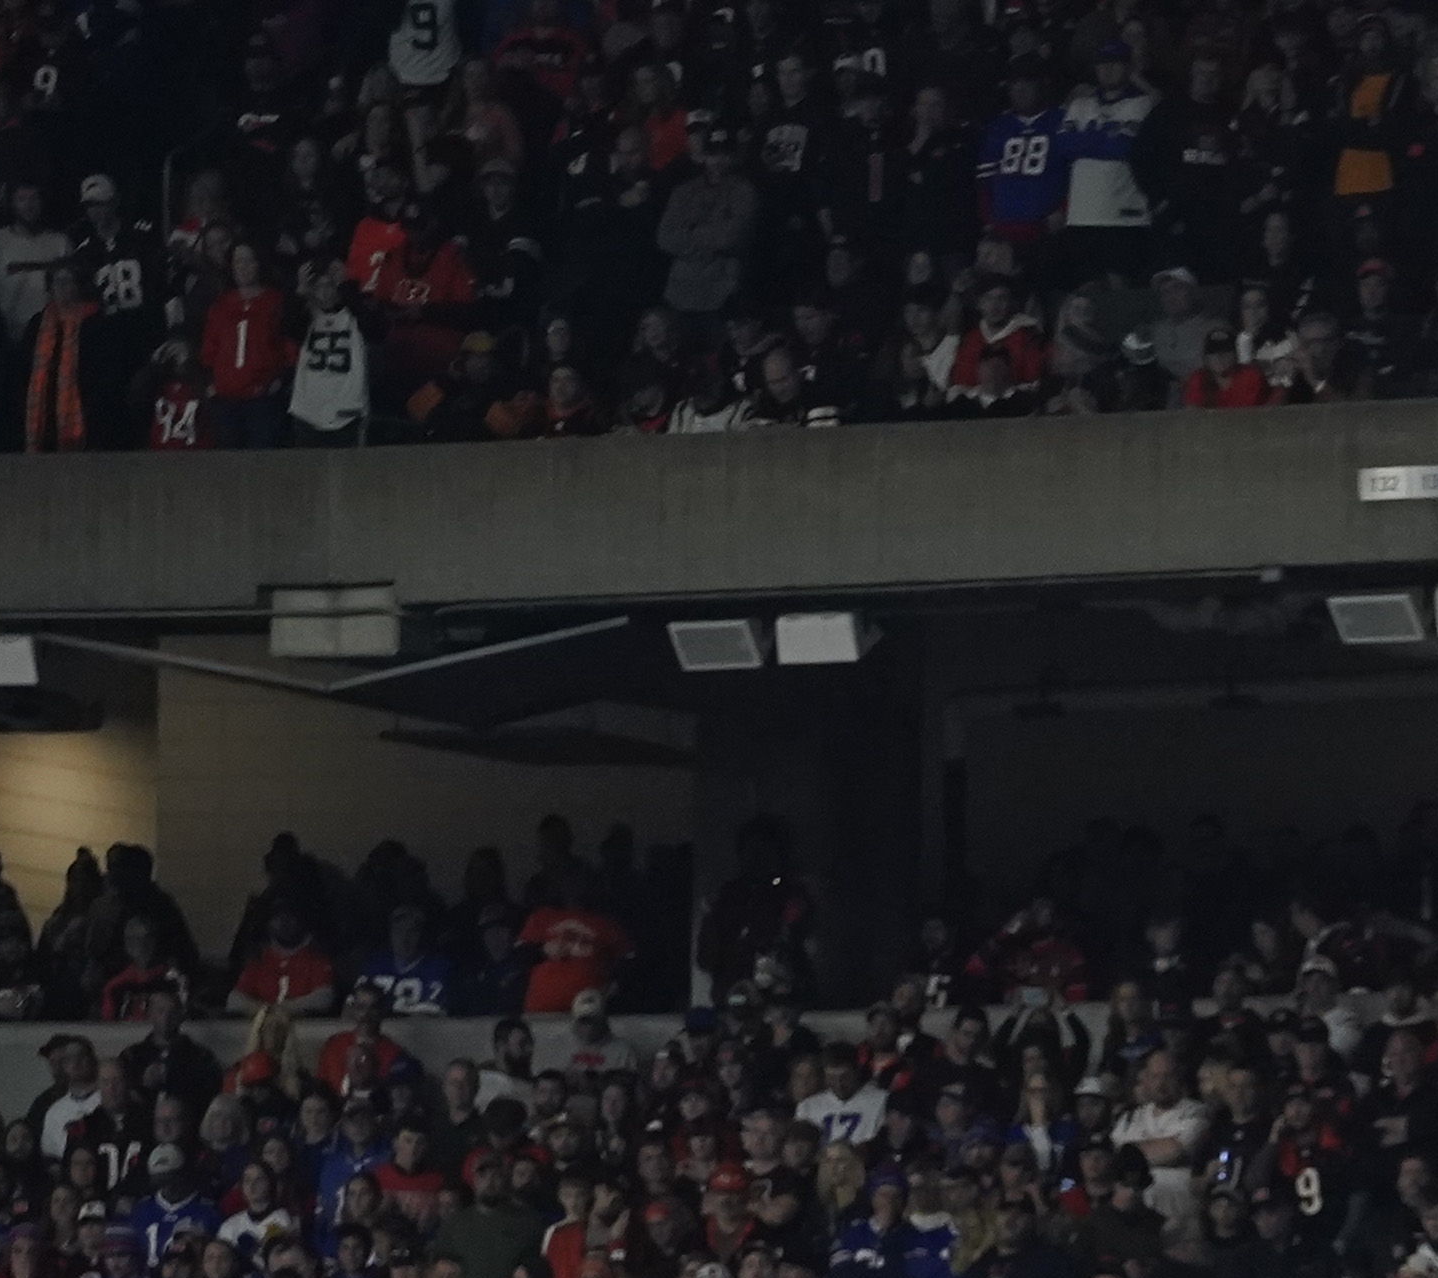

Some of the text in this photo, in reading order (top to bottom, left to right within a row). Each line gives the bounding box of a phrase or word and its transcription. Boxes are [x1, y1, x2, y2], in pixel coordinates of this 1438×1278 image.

[1002, 136, 1050, 177] 88
[235, 322, 247, 367] 1
[308, 331, 352, 373] 55
[1297, 1168, 1321, 1216] 9
